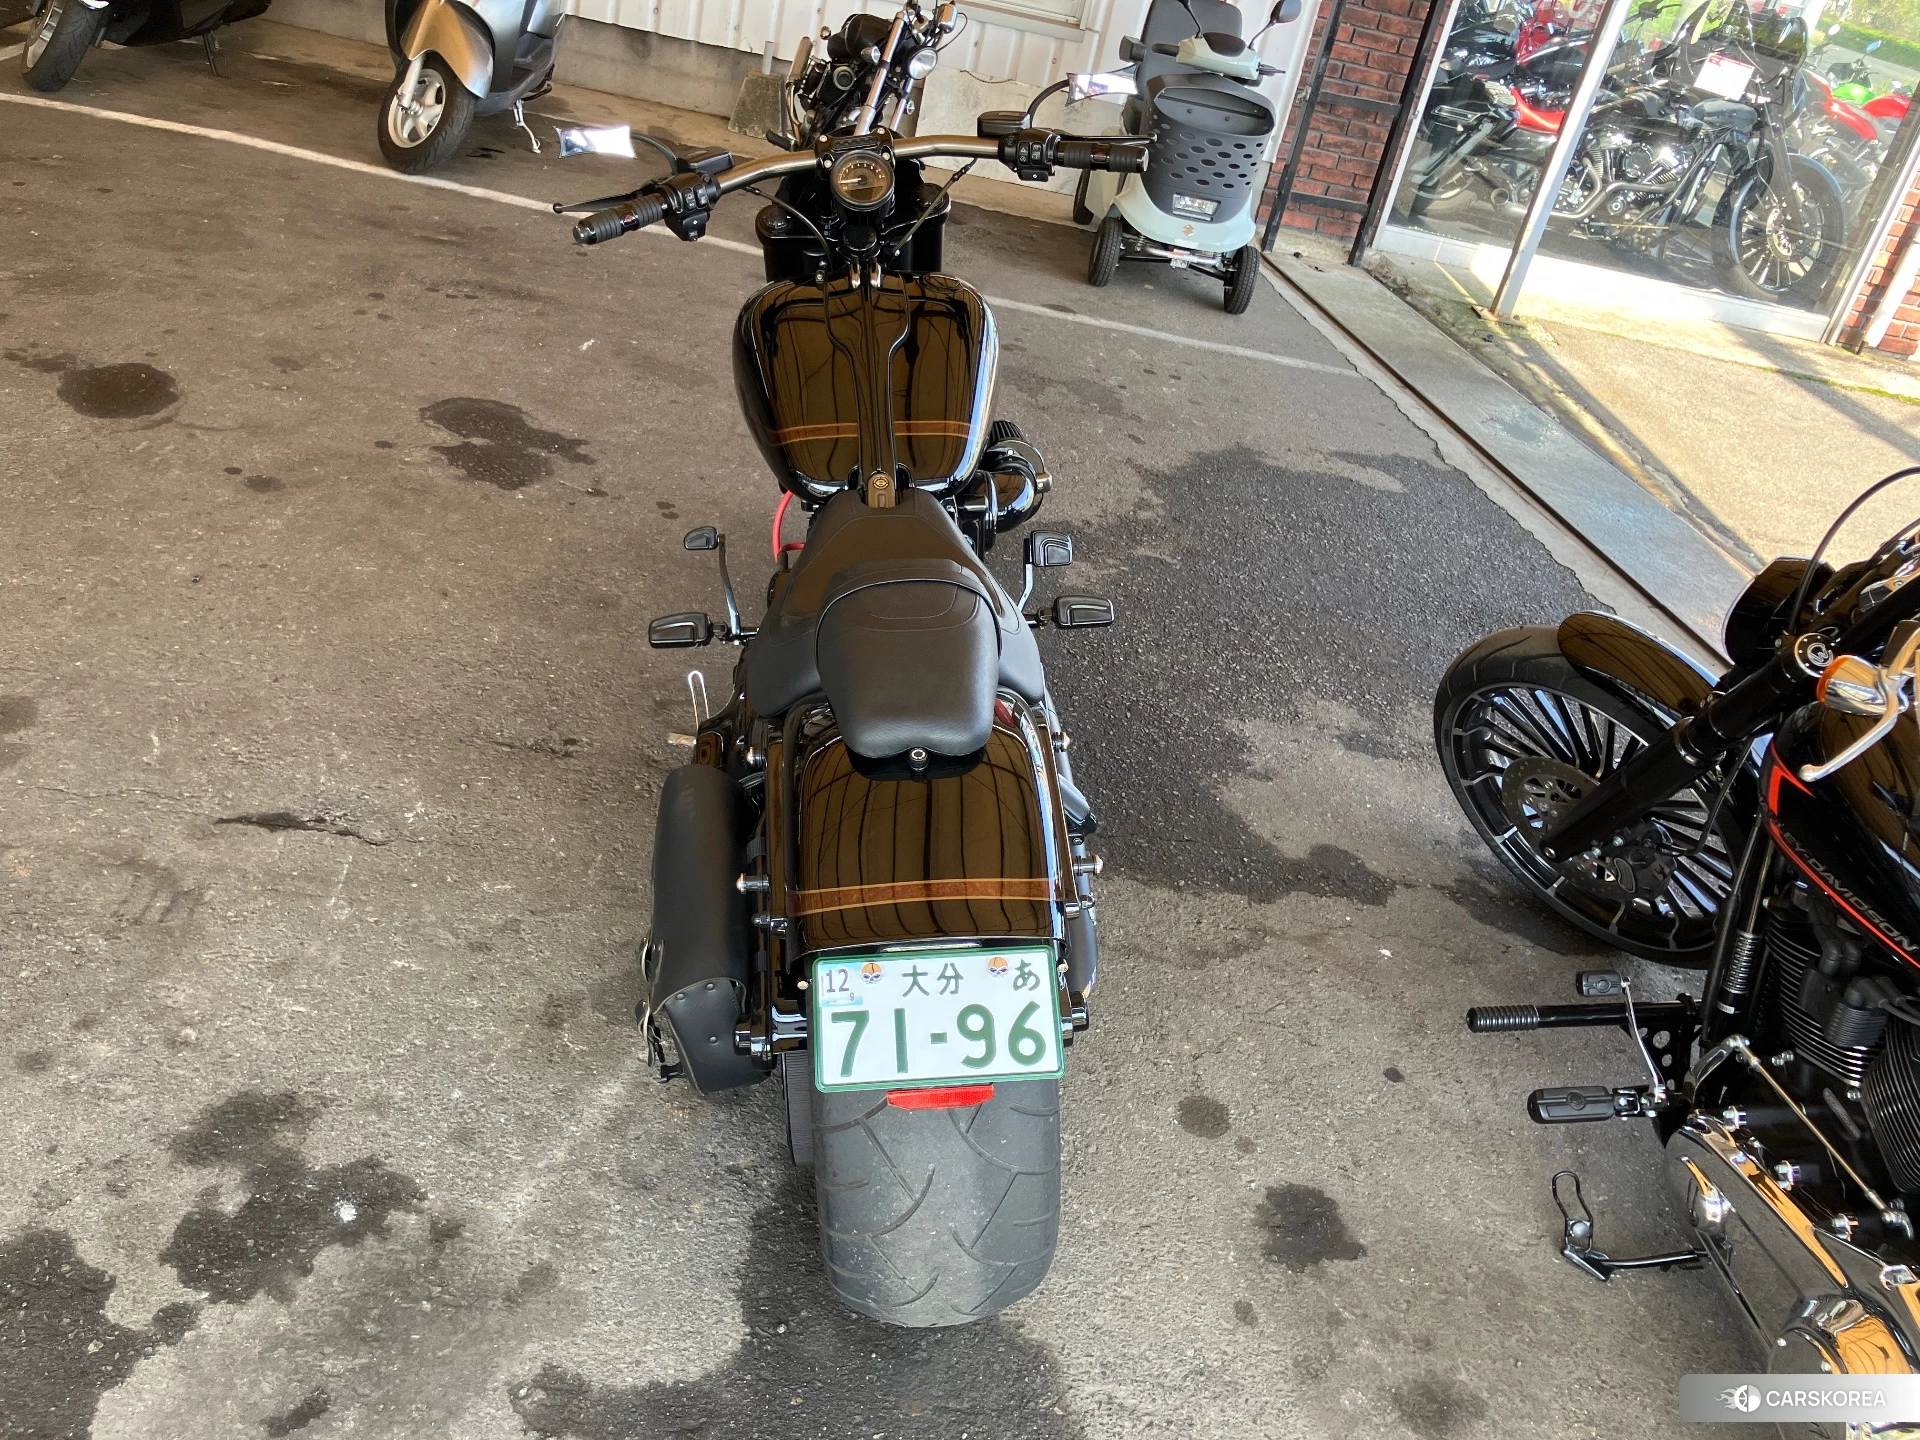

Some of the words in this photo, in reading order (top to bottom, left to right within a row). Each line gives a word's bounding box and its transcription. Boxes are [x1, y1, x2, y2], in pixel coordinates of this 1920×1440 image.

[825, 968, 850, 993] 12
[901, 962, 964, 997] 大分
[1012, 959, 1041, 991] あ
[830, 1000, 1047, 1078] 71-96
